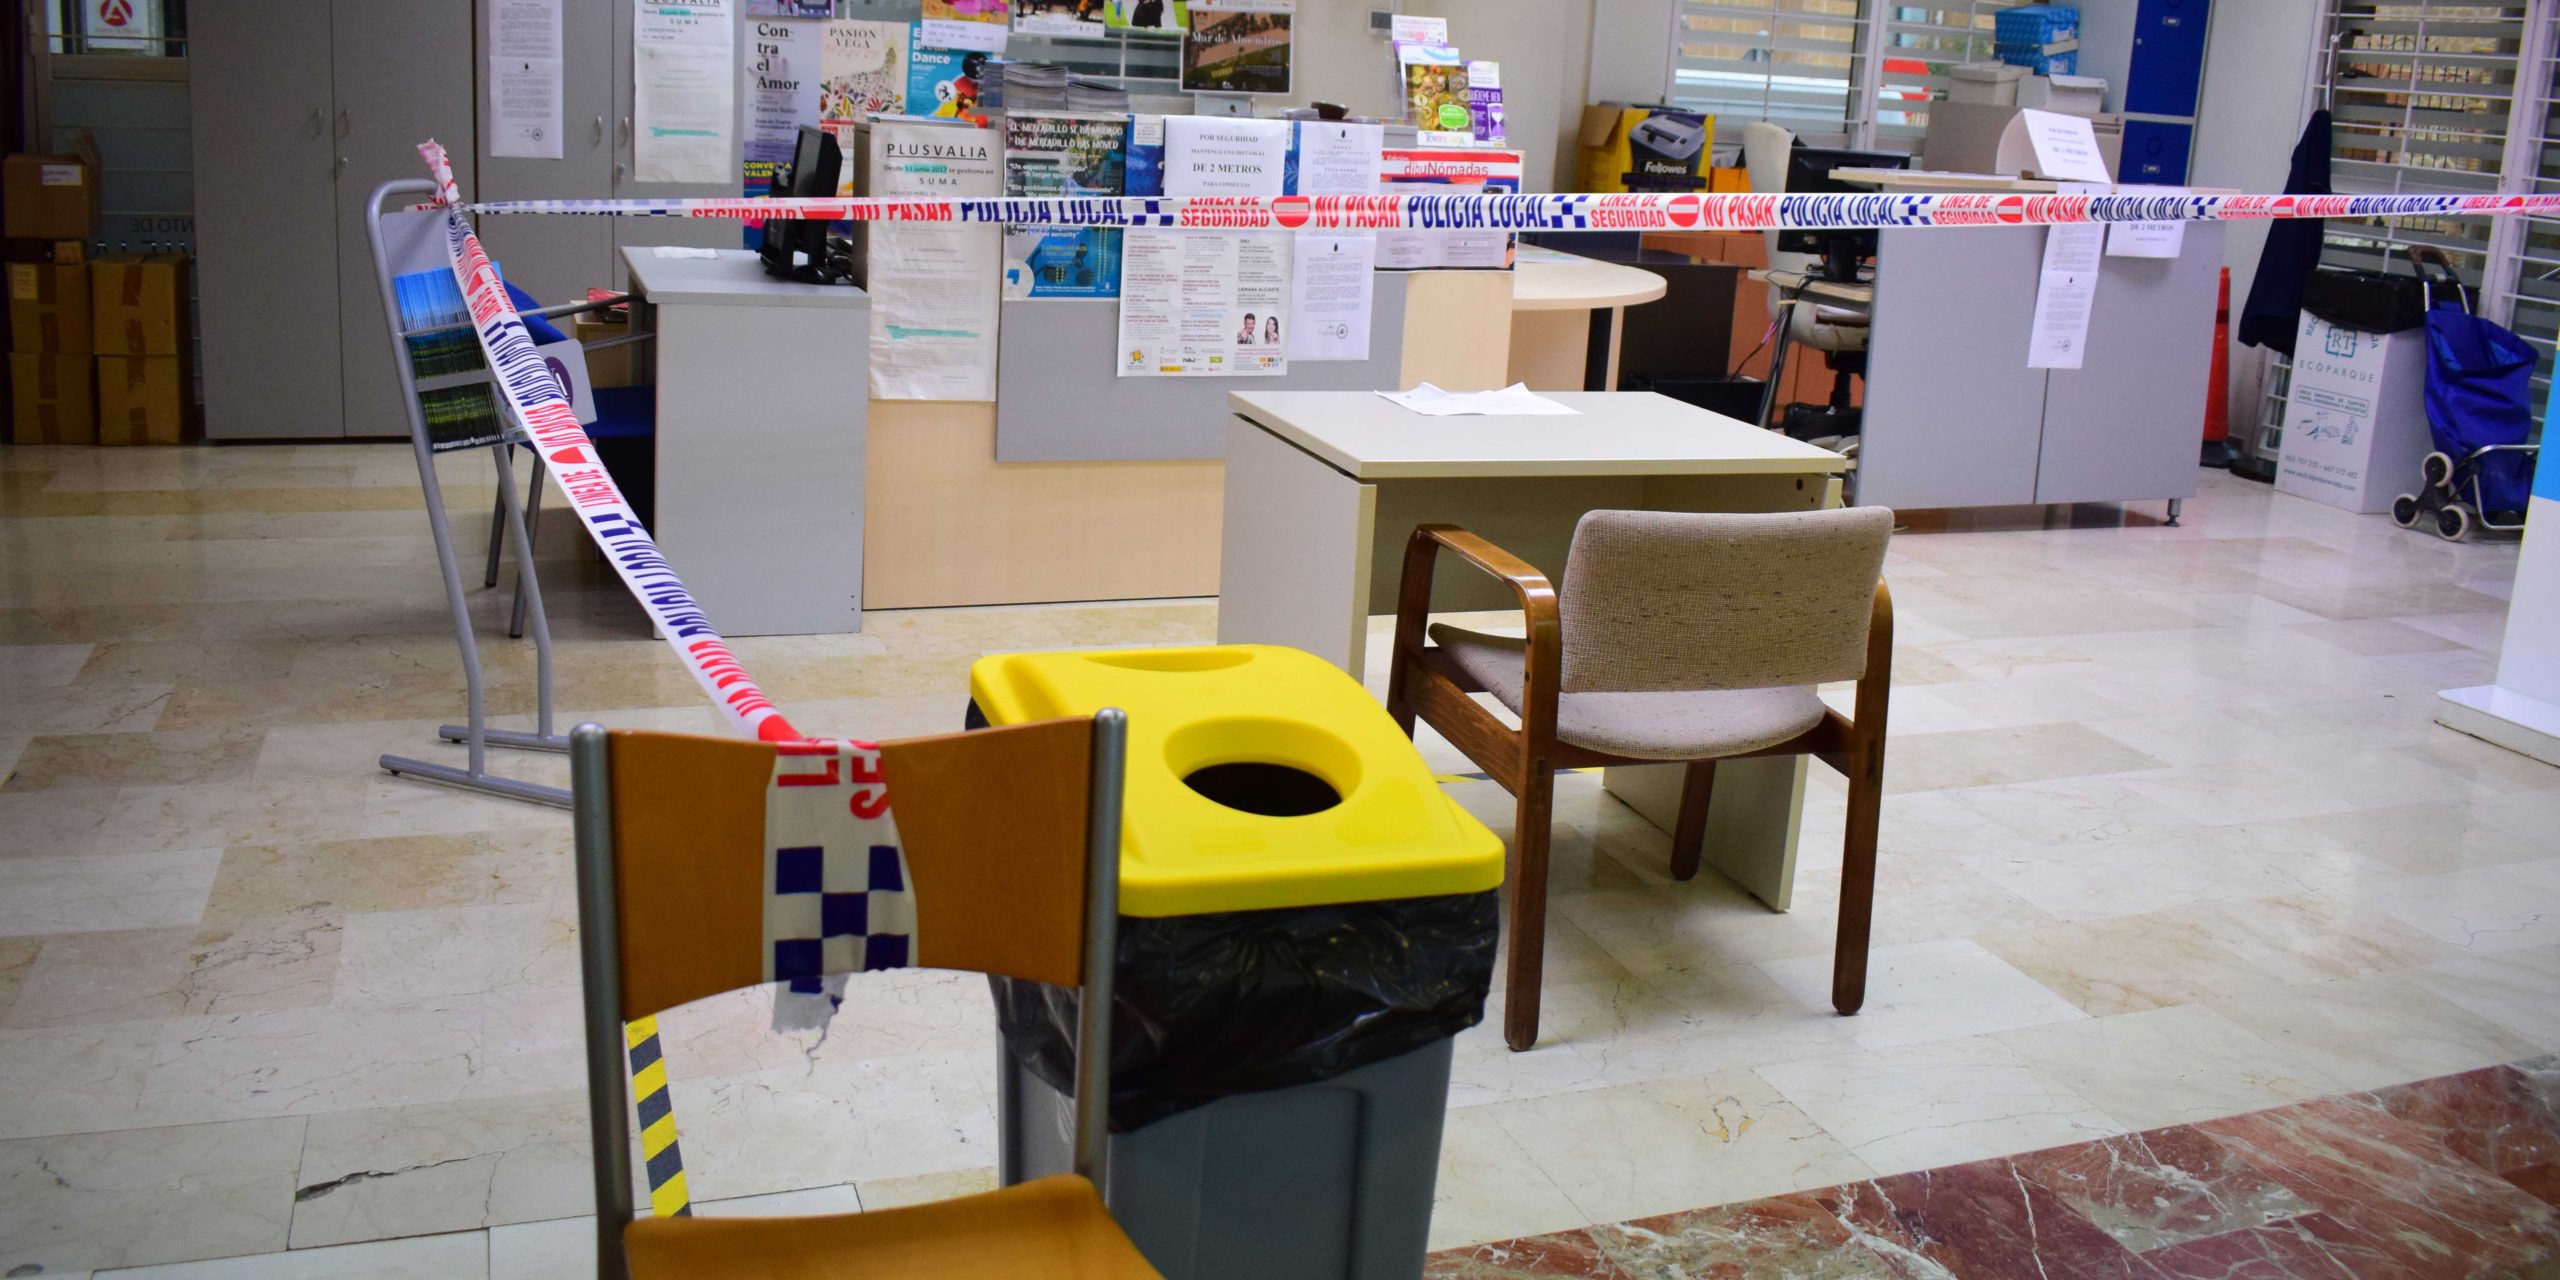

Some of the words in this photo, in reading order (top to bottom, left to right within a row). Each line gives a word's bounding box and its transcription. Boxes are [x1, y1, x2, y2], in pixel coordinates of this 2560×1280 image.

[834, 38, 871, 49] VEGA
[1191, 31, 1213, 43] Mar
[1214, 33, 1227, 43] de
[757, 43, 779, 54] tra
[757, 58, 770, 71] el
[911, 52, 950, 64] Dance
[756, 77, 799, 90] Amor
[1022, 122, 1068, 135] MERCADILLO
[1070, 124, 1078, 133] SE
[1030, 137, 1075, 149] MERCADILLO
[1216, 135, 1258, 143] SEGURIDAD
[887, 143, 987, 158] PLUSVALIA
[957, 168, 984, 176] gestiona
[1193, 163, 1206, 172] DE
[1209, 163, 1216, 172] 2
[1218, 164, 1262, 174] METROS
[1404, 163, 1488, 175] dibuNómadas
[1645, 161, 1687, 175] Fellowes
[919, 177, 957, 186] SUMA
[1640, 195, 1660, 207] DE
[1976, 195, 1992, 208] DE
[887, 204, 953, 221] PASAR
[961, 200, 1051, 223] POLICIA
[1058, 200, 1128, 224] LOCAL
[1315, 195, 1340, 228] NO
[1345, 195, 1401, 229] PASAR
[1407, 195, 1485, 229] POLICIA
[1489, 195, 1549, 229] LOCAL
[1703, 195, 1724, 227] NO
[1728, 195, 1777, 227] PASAR
[1780, 195, 1843, 227] POLICIA
[1850, 195, 1899, 226] LOCAL
[2025, 196, 2046, 223] NO
[2047, 196, 2090, 223] PASAR
[2090, 196, 2144, 222] POLICIA
[2146, 196, 2191, 222] LOCAL
[1180, 208, 1270, 228] SEGURIDAD
[1590, 209, 1666, 228] SEGURIDAD
[1932, 210, 1998, 225] SEGURIDAD
[2331, 332, 2353, 350] RT
[2299, 359, 2375, 384] ECOPARQUE
